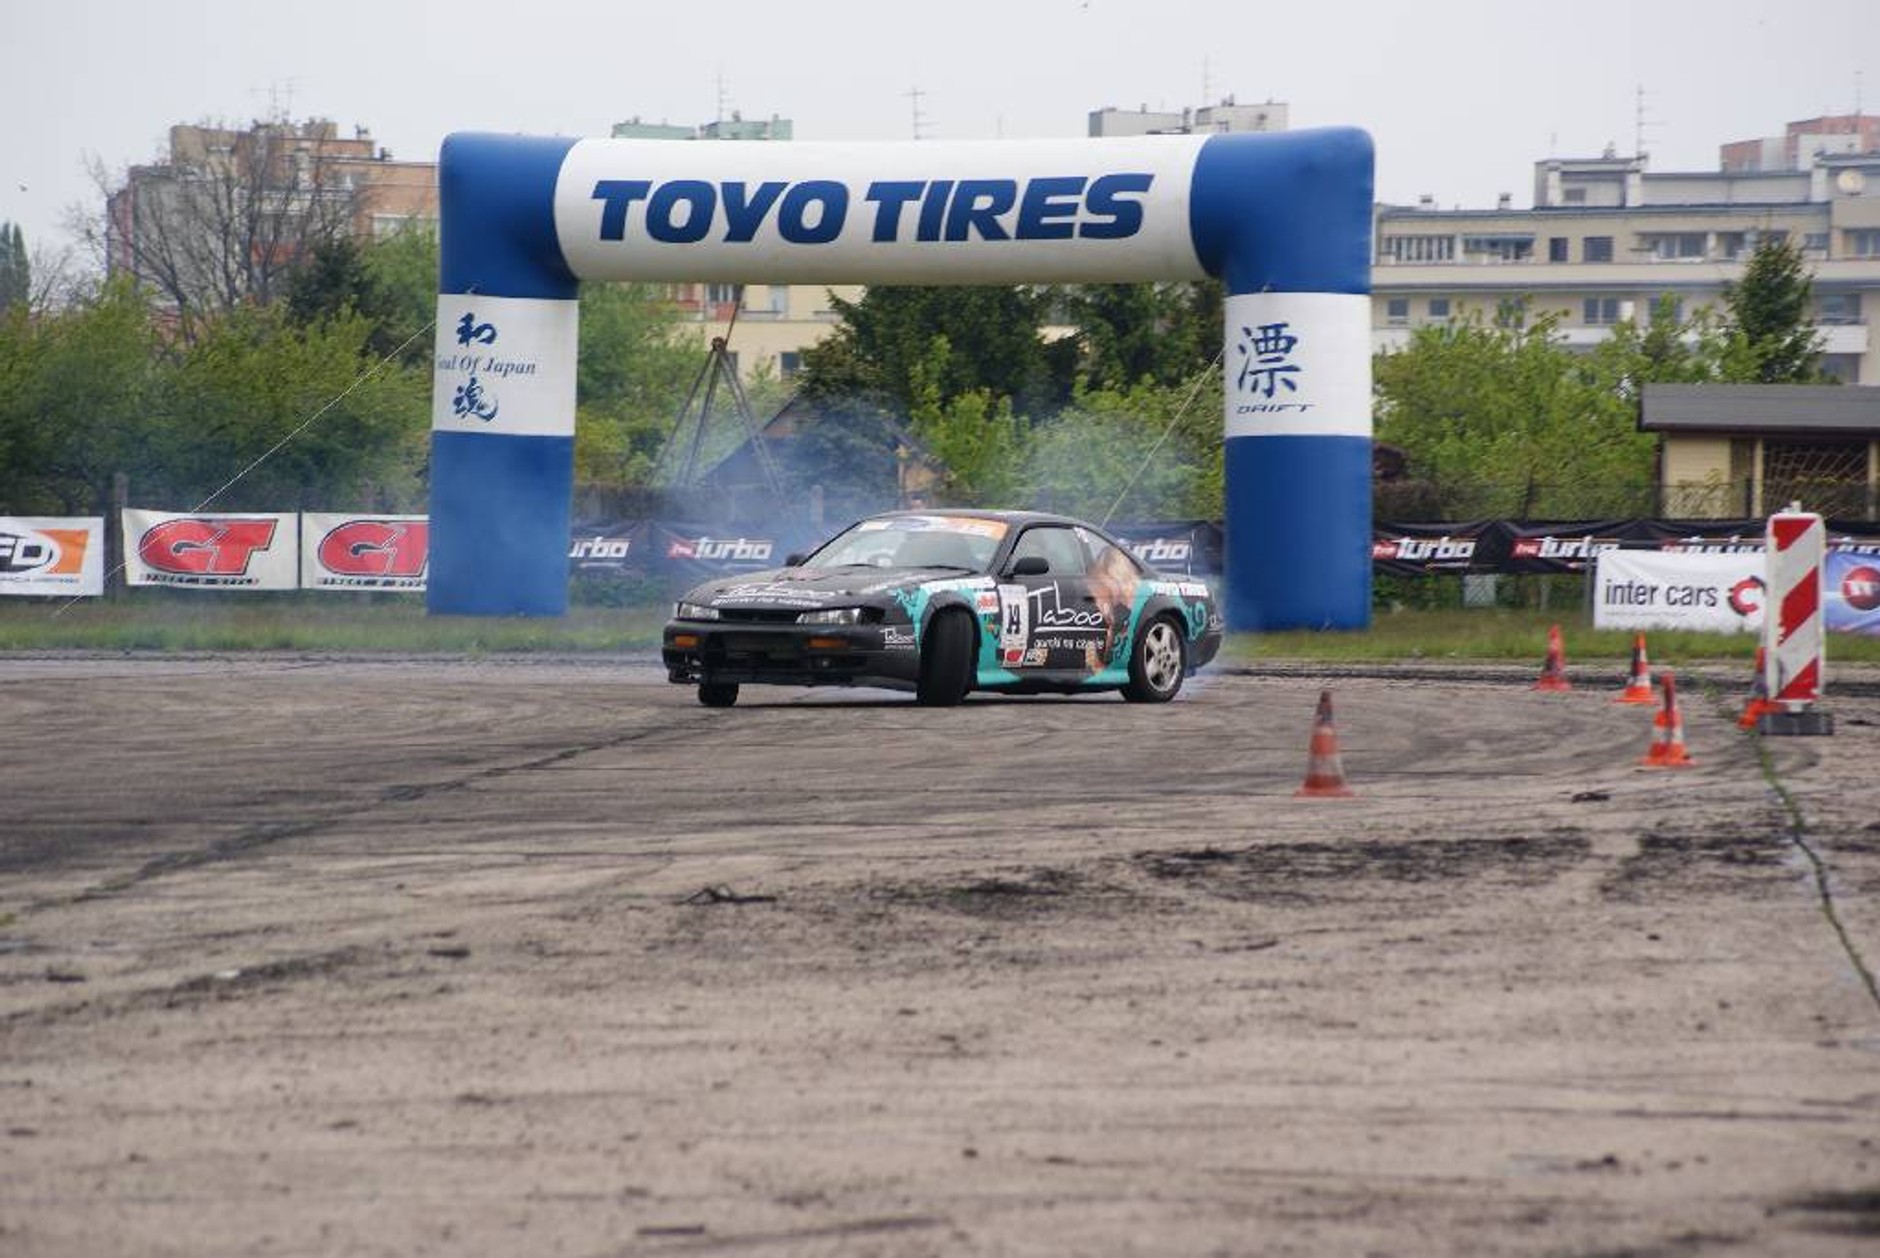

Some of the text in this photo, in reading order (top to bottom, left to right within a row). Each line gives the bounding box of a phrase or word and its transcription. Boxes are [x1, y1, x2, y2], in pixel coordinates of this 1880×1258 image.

[591, 173, 1156, 244] TOYO TIRES
[456, 312, 497, 347] 和
[460, 355, 482, 375] Of
[483, 357, 536, 378] Japan
[1237, 322, 1302, 399] 漂
[1236, 403, 1317, 415] DRIFT
[138, 518, 279, 576] GT
[694, 536, 773, 559] turbo
[1395, 535, 1476, 559] turbo
[1026, 579, 1104, 626] Taboo
[1605, 579, 1657, 605] inter
[1666, 585, 1718, 607] cars
